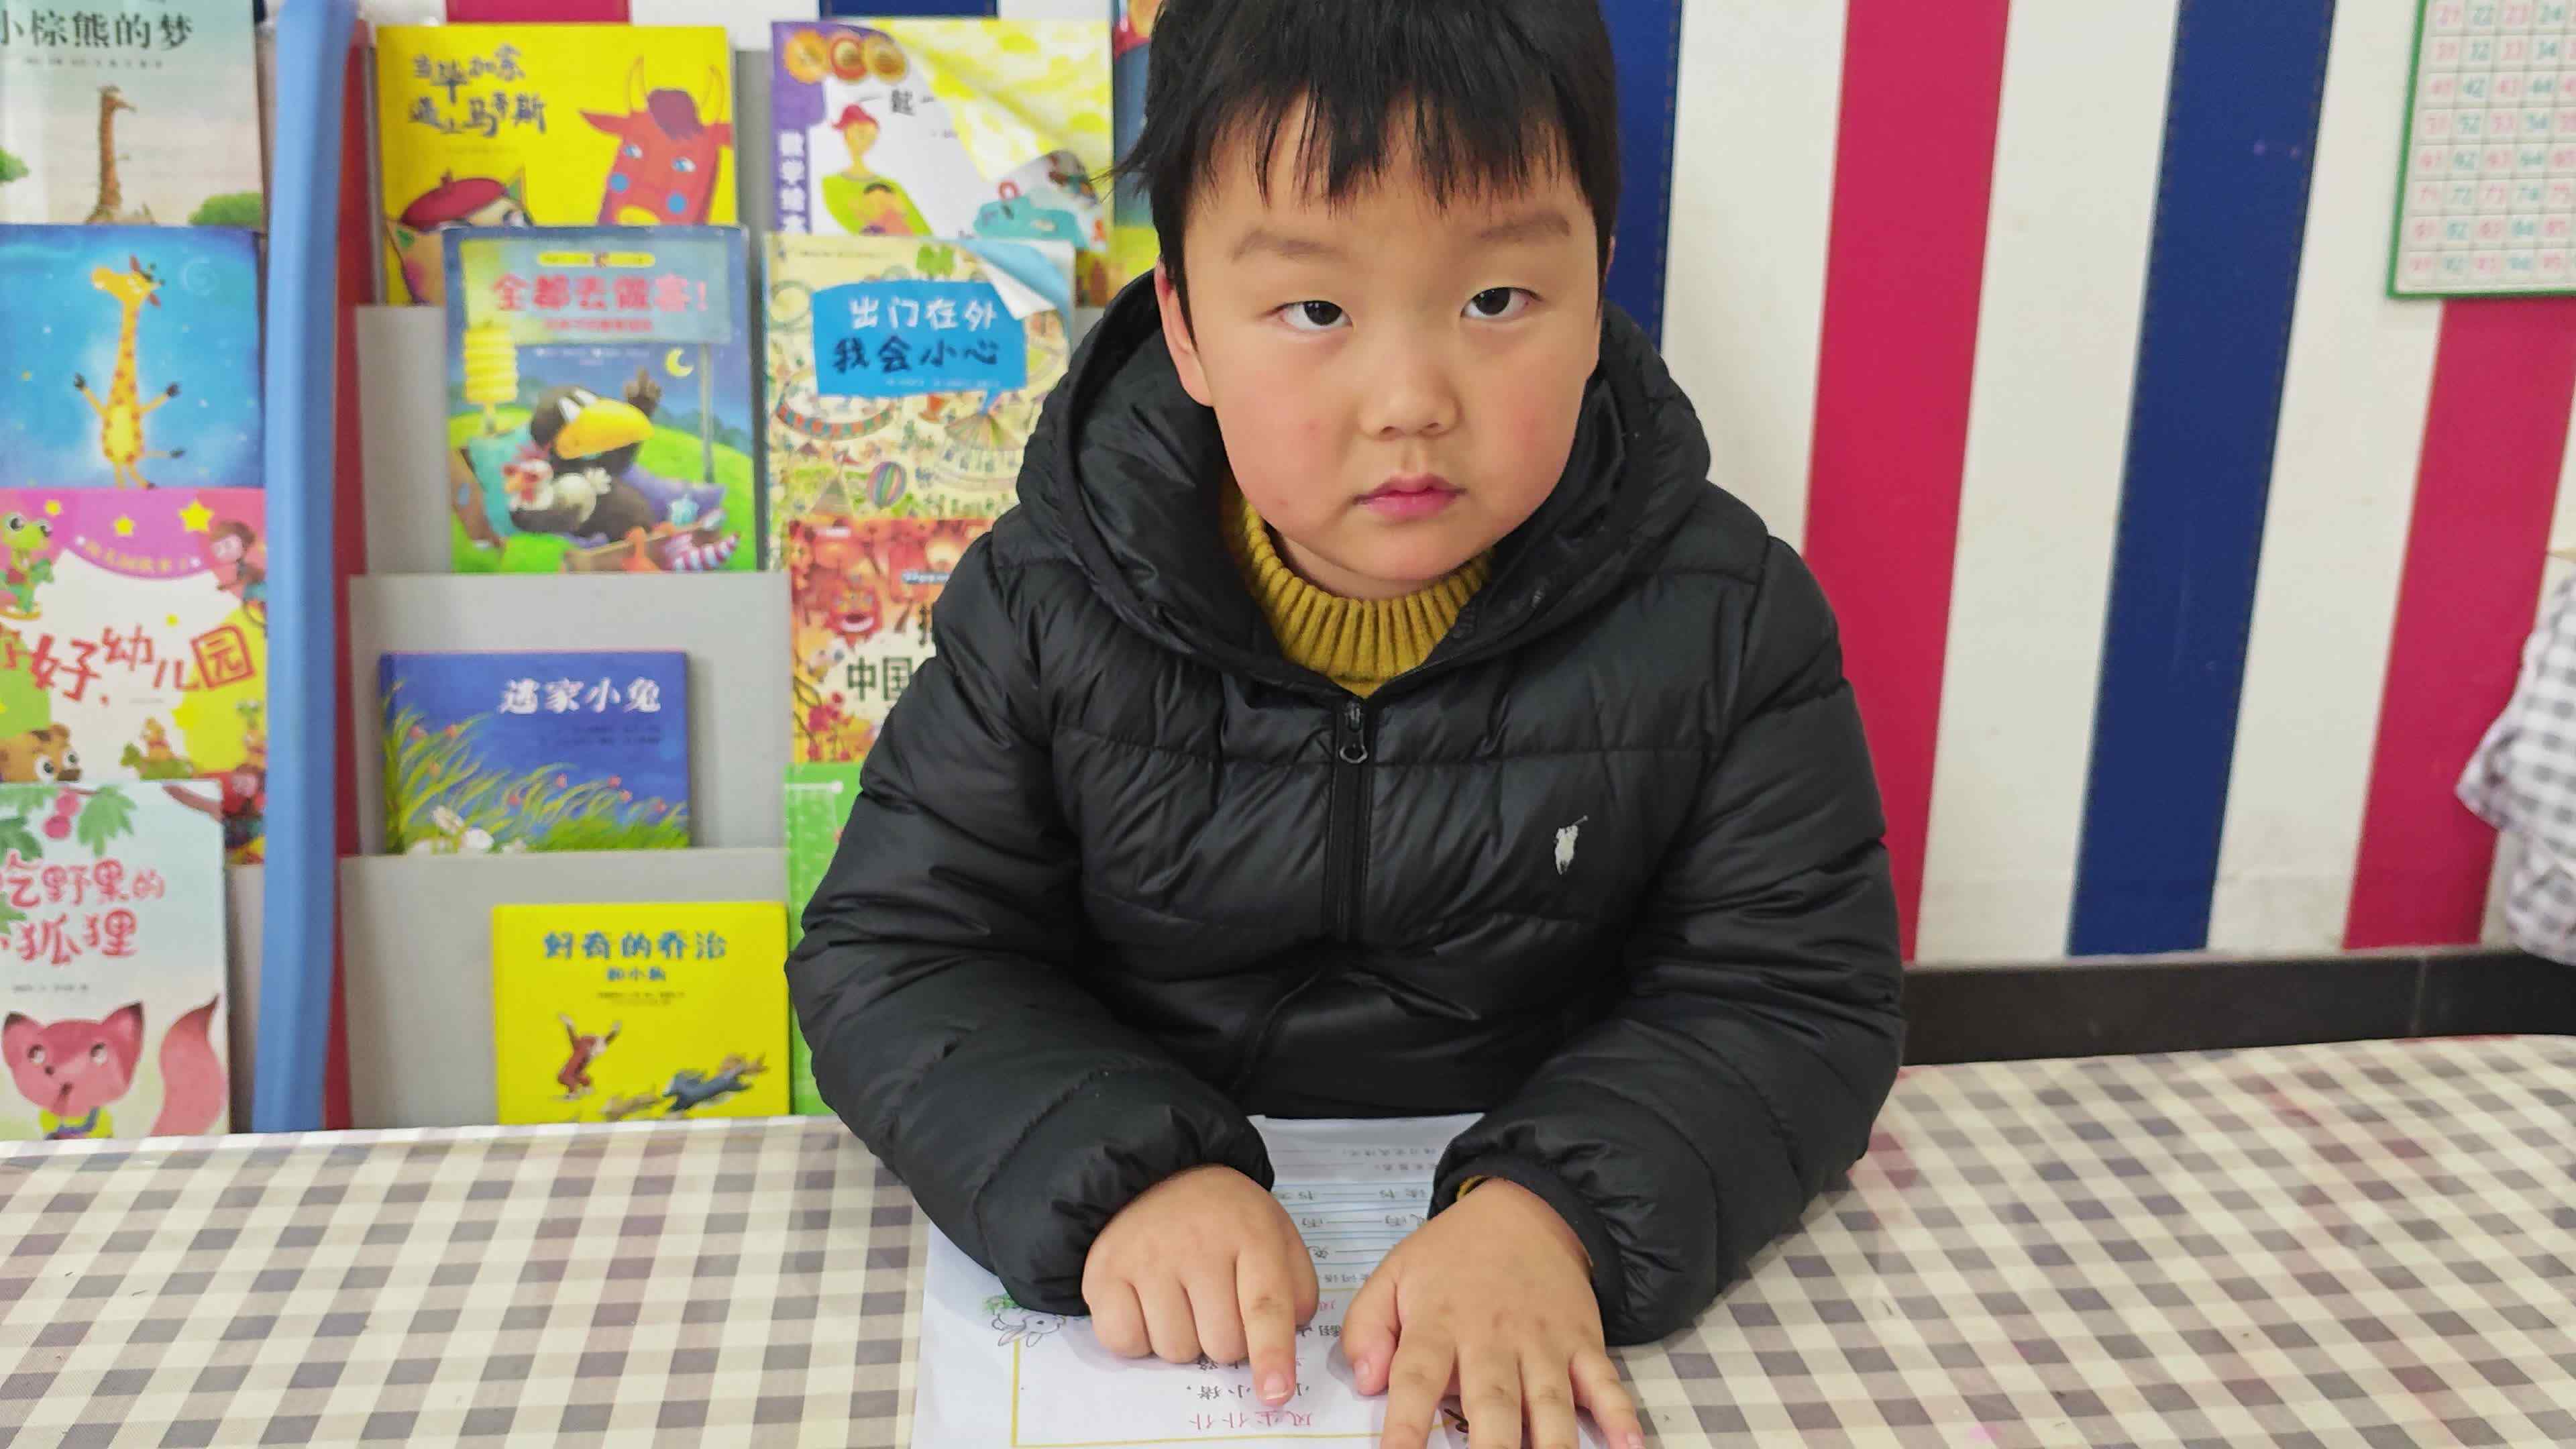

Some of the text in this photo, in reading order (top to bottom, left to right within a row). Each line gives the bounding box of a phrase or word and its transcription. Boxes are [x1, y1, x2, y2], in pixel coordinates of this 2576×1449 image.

[0, 11, 193, 50] 小棕熊的梦
[849, 298, 997, 331] 出门在外
[832, 335, 1000, 374] 我会小心
[498, 676, 661, 714] 逃家小兔
[0, 908, 138, 966] 狐狸
[543, 930, 727, 960] 好奇的乔治
[1188, 1411, 1312, 1431] 风尘仆仆
